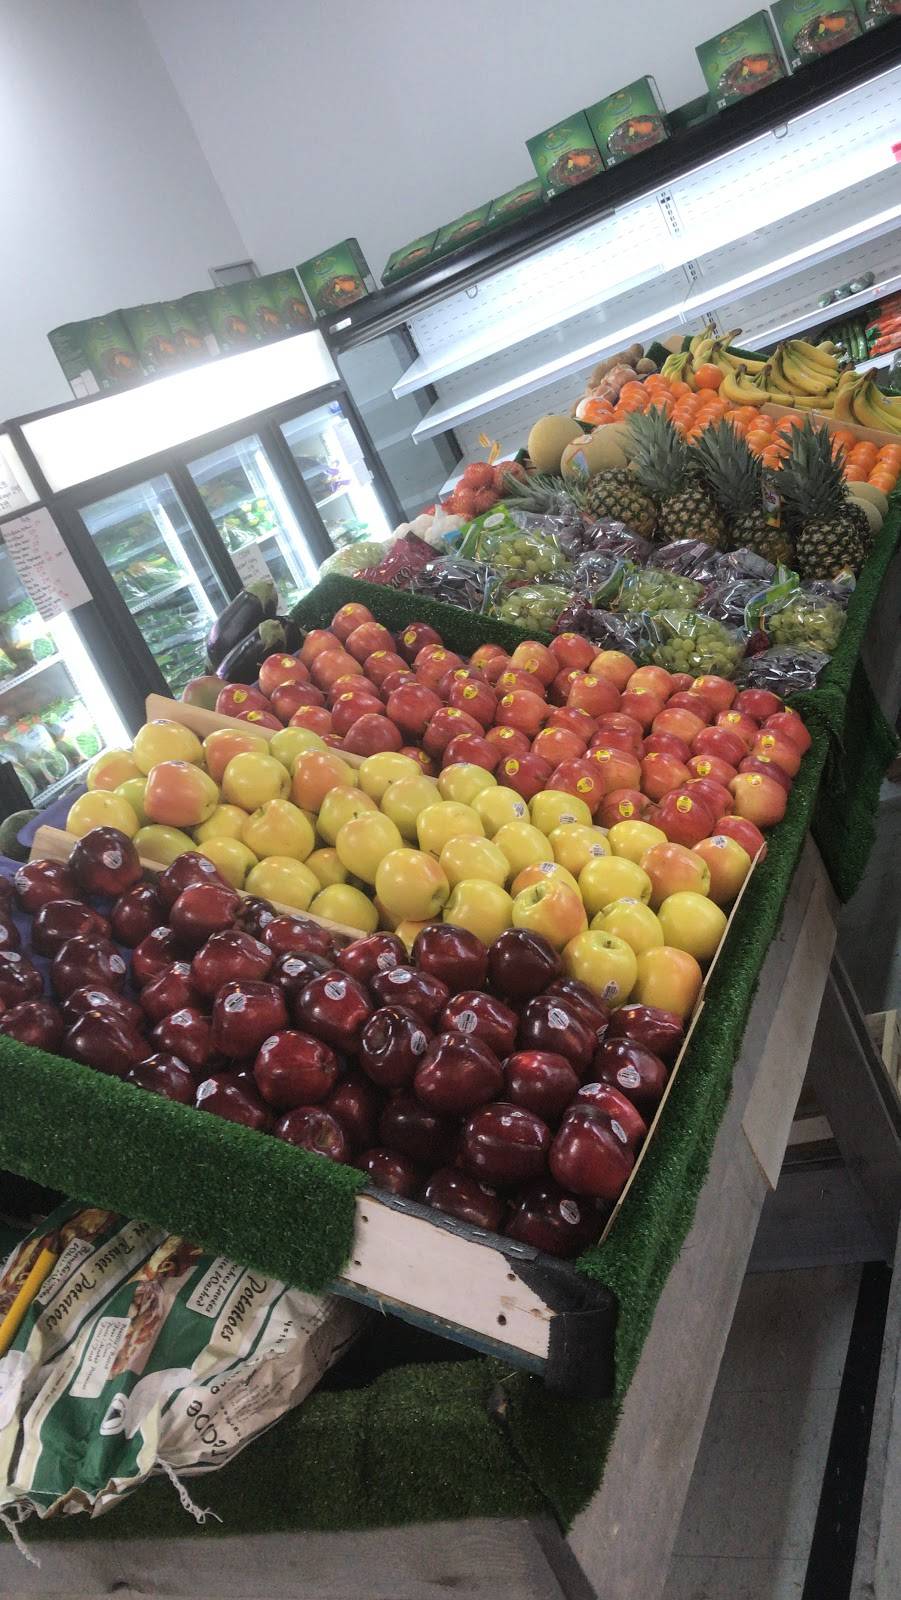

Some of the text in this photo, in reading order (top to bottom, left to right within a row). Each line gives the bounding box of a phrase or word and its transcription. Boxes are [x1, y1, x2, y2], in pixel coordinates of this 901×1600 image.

[95, 1239, 135, 1273] Russet
[46, 1272, 97, 1331] Potatoes
[197, 1270, 222, 1307] Washed
[221, 1275, 267, 1342] Potatoes
